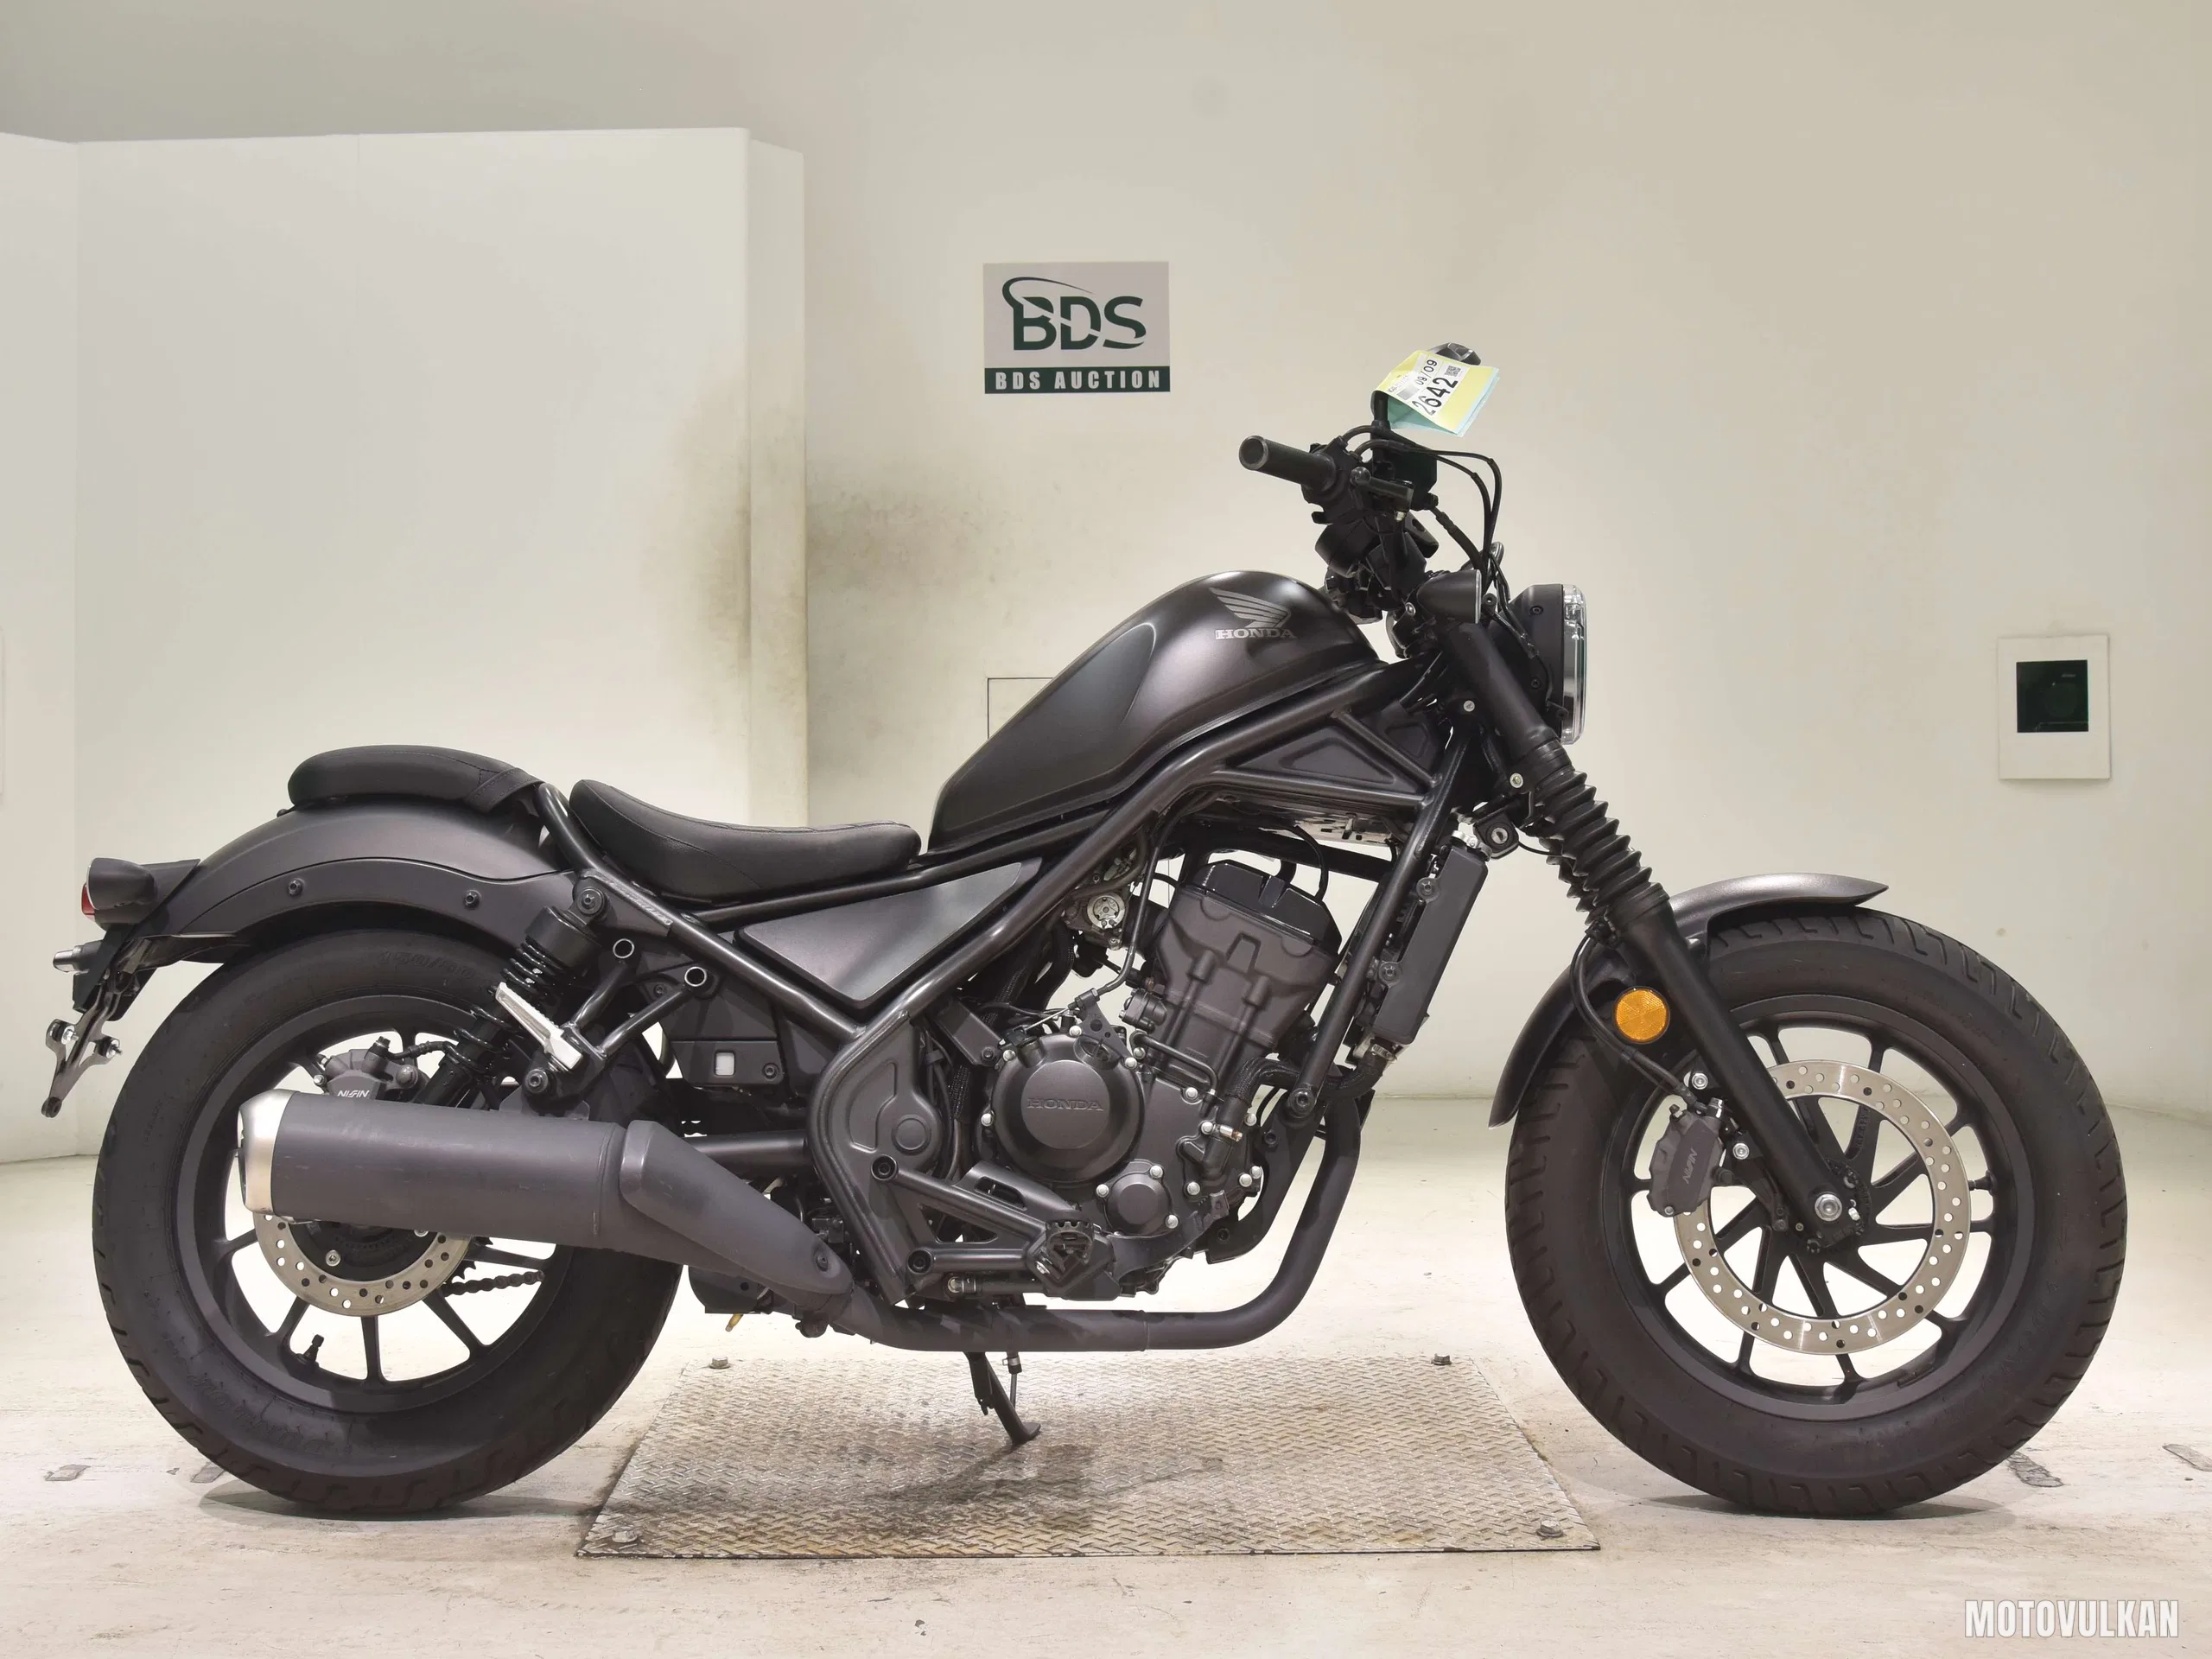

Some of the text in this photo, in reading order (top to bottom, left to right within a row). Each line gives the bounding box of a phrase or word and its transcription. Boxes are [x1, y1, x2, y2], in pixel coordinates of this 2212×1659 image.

[1002, 276, 1147, 351] BDS
[995, 370, 1160, 391] BDS AUCTION
[1414, 359, 1438, 385] 09/09
[1411, 377, 1459, 416] 2642
[1215, 628, 1298, 640] HONDA
[1026, 1097, 1105, 1111] HONDA
